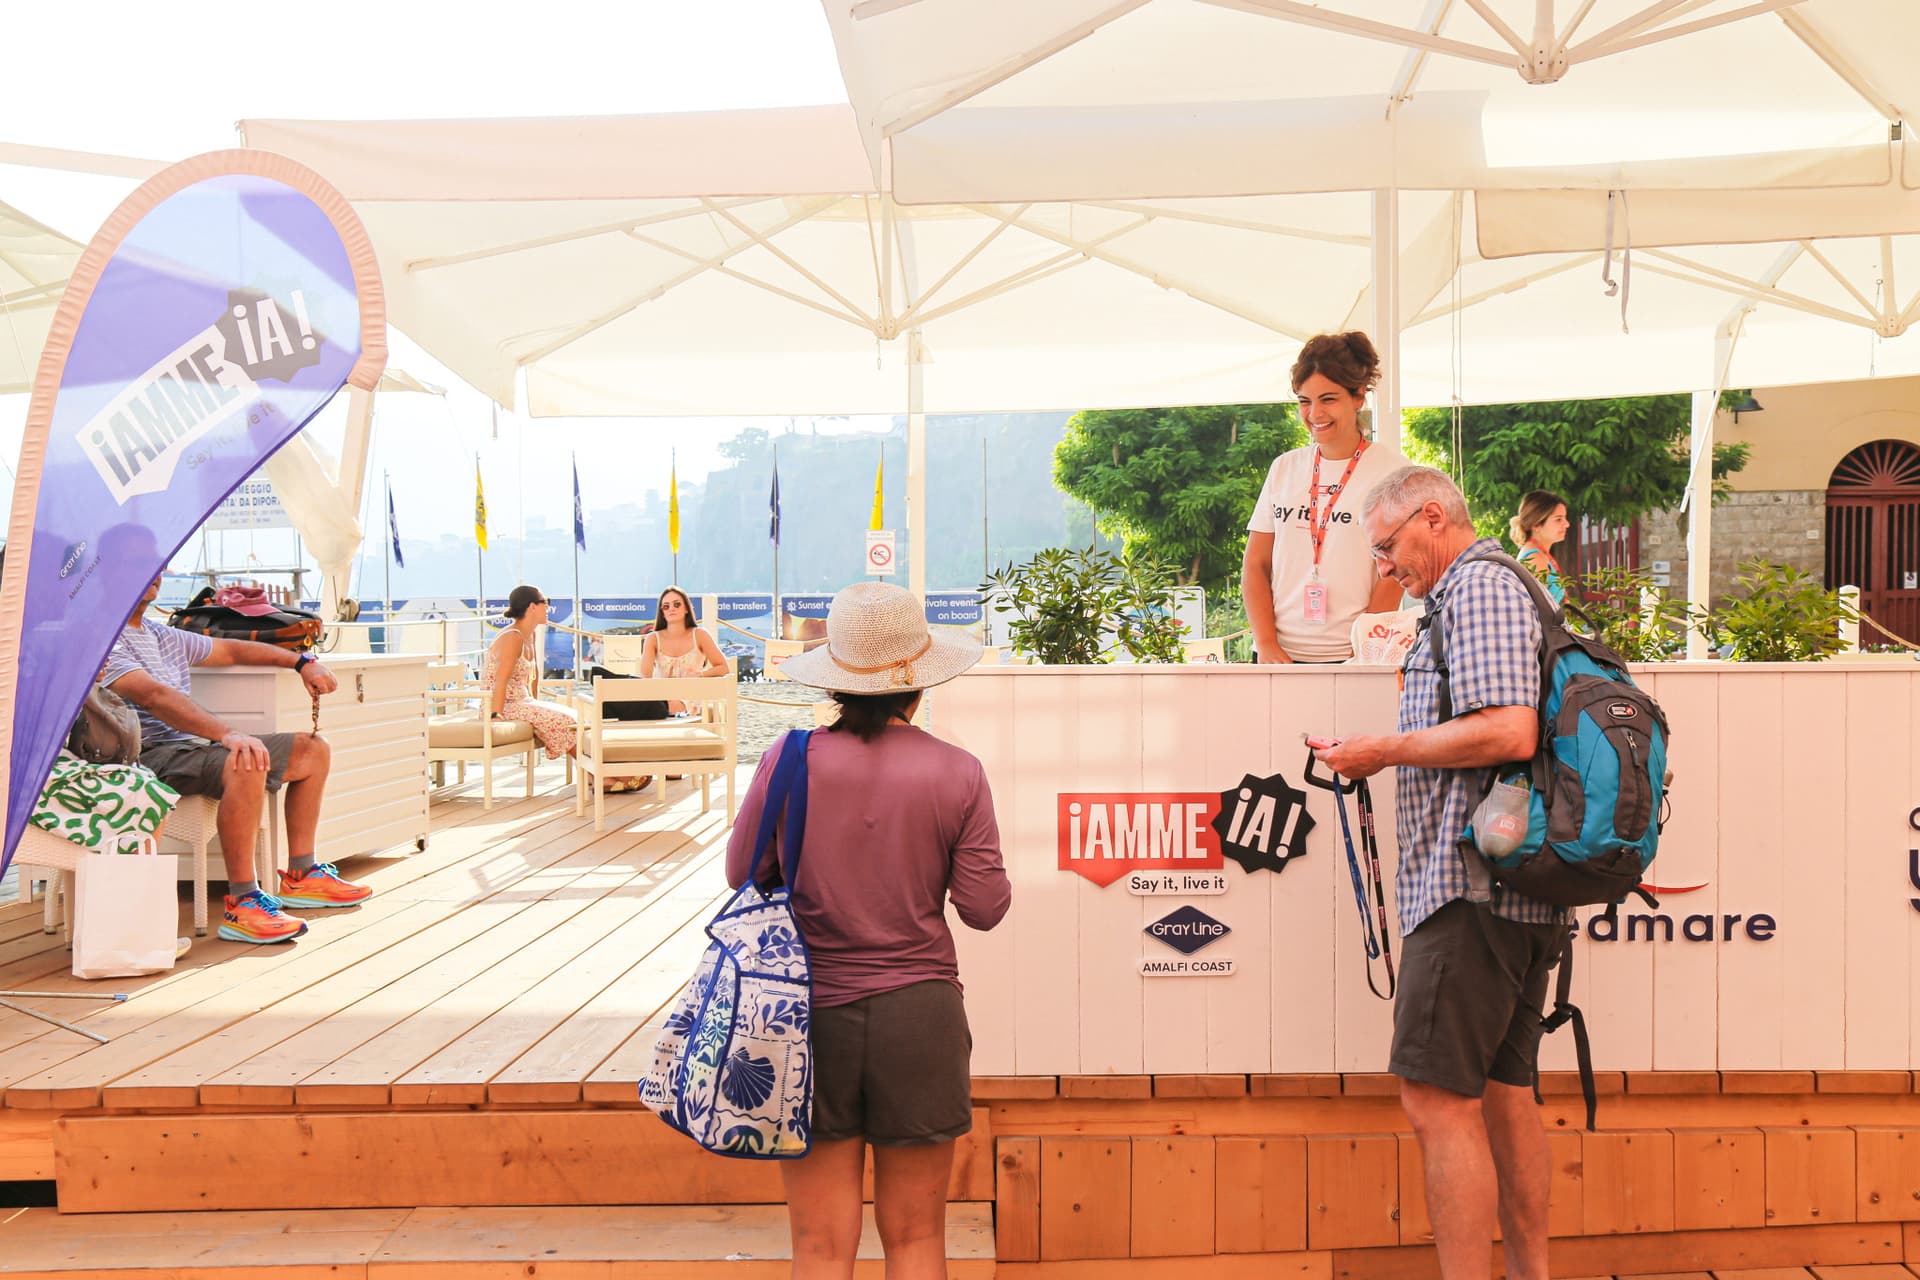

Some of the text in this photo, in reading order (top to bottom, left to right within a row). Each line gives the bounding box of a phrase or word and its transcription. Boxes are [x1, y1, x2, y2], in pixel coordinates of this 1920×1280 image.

[236, 484, 272, 494] MEGGIO
[585, 602, 646, 612] Boat excursions
[733, 601, 767, 611] transfers
[797, 600, 824, 610] Sunset
[937, 611, 978, 620] on board
[1130, 876, 1225, 893] Say it, live it
[224, 912, 238, 923] OKA
[1152, 921, 1224, 936] Gray Line
[1143, 961, 1233, 973] AMALFI COAST
